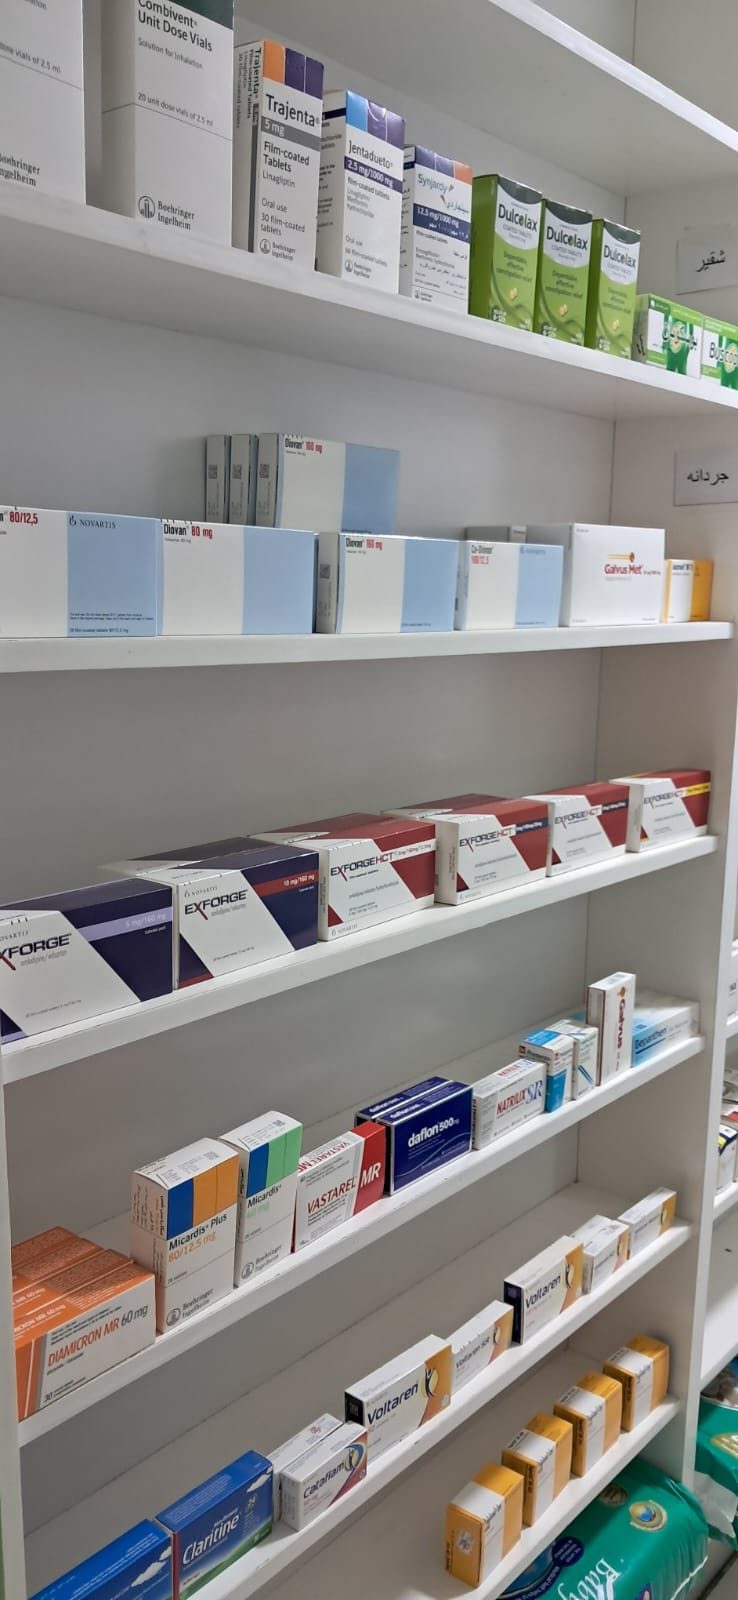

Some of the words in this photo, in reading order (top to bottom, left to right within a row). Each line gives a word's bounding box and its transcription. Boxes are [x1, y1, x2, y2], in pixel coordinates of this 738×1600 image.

[138, 10, 160, 31] Unit
[163, 23, 188, 41] Dose
[189, 33, 213, 52] Vials
[15, 47, 31, 61] vials
[32, 56, 40, 65] of
[40, 58, 51, 71] 2.5
[52, 64, 61, 74] ml
[138, 37, 164, 54] Solution
[165, 47, 174, 57] for
[174, 52, 203, 69] Inhalation
[138, 92, 147, 102] 20
[147, 95, 160, 106] unit
[161, 100, 174, 112] dose
[175, 104, 188, 117] vials
[189, 110, 197, 120] of
[197, 113, 206, 124] 2.5
[206, 118, 214, 127] ml
[265, 94, 317, 127] Trajenta
[265, 119, 271, 130] 5
[271, 123, 285, 137] mg
[0, 153, 40, 175] oehringer
[263, 154, 292, 172] Tablets
[264, 141, 310, 166] Film-coated
[348, 140, 391, 169] Jentadueto
[262, 170, 296, 188] Linagliptin
[347, 160, 358, 171] 2.5
[384, 177, 394, 189] mg
[417, 173, 448, 194] Synjardy
[158, 200, 195, 220] Boehringer
[262, 198, 275, 209] Oral
[276, 204, 287, 213] use
[417, 205, 429, 217] 12.5
[157, 212, 191, 230] Ingelheim
[261, 213, 270, 222] 30
[270, 215, 306, 232] film-coated
[261, 223, 282, 236] tablets
[498, 204, 538, 233] Dulcolax
[546, 227, 588, 251] Dulcolax
[603, 244, 636, 268] Dulcolax
[285, 438, 303, 450] Diovan
[9, 511, 38, 526] 80/12,5
[79, 519, 117, 529] NOVARTIS
[163, 523, 187, 536] Diovan
[191, 525, 201, 536] 80
[202, 528, 213, 540] mg
[345, 538, 363, 549] Diovan
[604, 563, 628, 576] Galvus
[628, 563, 643, 575] Met
[184, 889, 248, 921] EXFORGE
[496, 1090, 525, 1115] NATRILIX
[526, 1080, 543, 1103] SR
[408, 1124, 439, 1148] daflon
[247, 1187, 279, 1209] Micardis
[307, 1178, 356, 1214] VASTAREL
[360, 1162, 382, 1189] MR
[168, 1227, 206, 1251] Micardis
[210, 1213, 228, 1228] Plus
[168, 1239, 202, 1263] 80/12.5
[202, 1233, 217, 1249] mg
[525, 1275, 562, 1308] Voltaren
[47, 1328, 103, 1367] DIAMICRON
[103, 1317, 120, 1336] MR
[121, 1310, 133, 1326] 60
[133, 1304, 149, 1321] mg
[367, 1382, 419, 1425] Voltaren
[303, 1462, 344, 1499] Cataflam
[182, 1514, 240, 1565] Claritine
